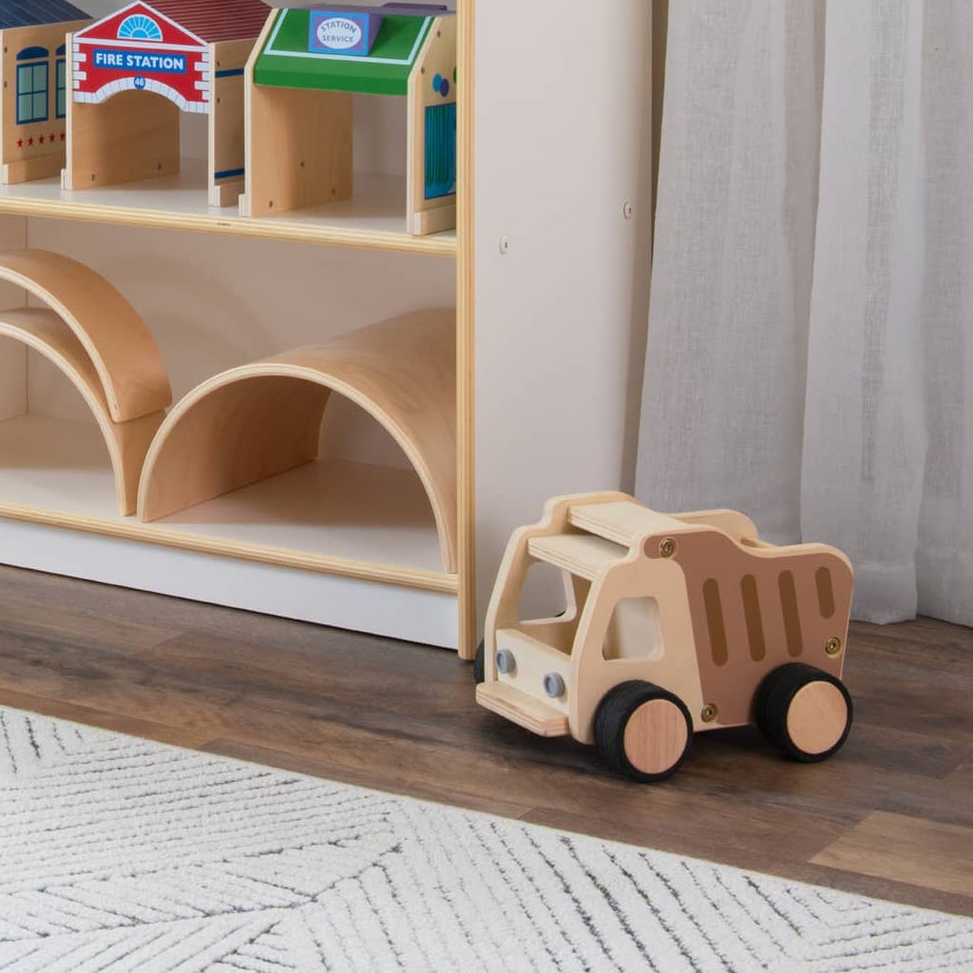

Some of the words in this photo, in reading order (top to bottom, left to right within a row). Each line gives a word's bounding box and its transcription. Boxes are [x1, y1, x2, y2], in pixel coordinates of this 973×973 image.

[321, 20, 357, 33] STATION
[322, 34, 354, 43] SERVICE
[95, 53, 123, 66] FIRE
[126, 55, 184, 70] STATION
